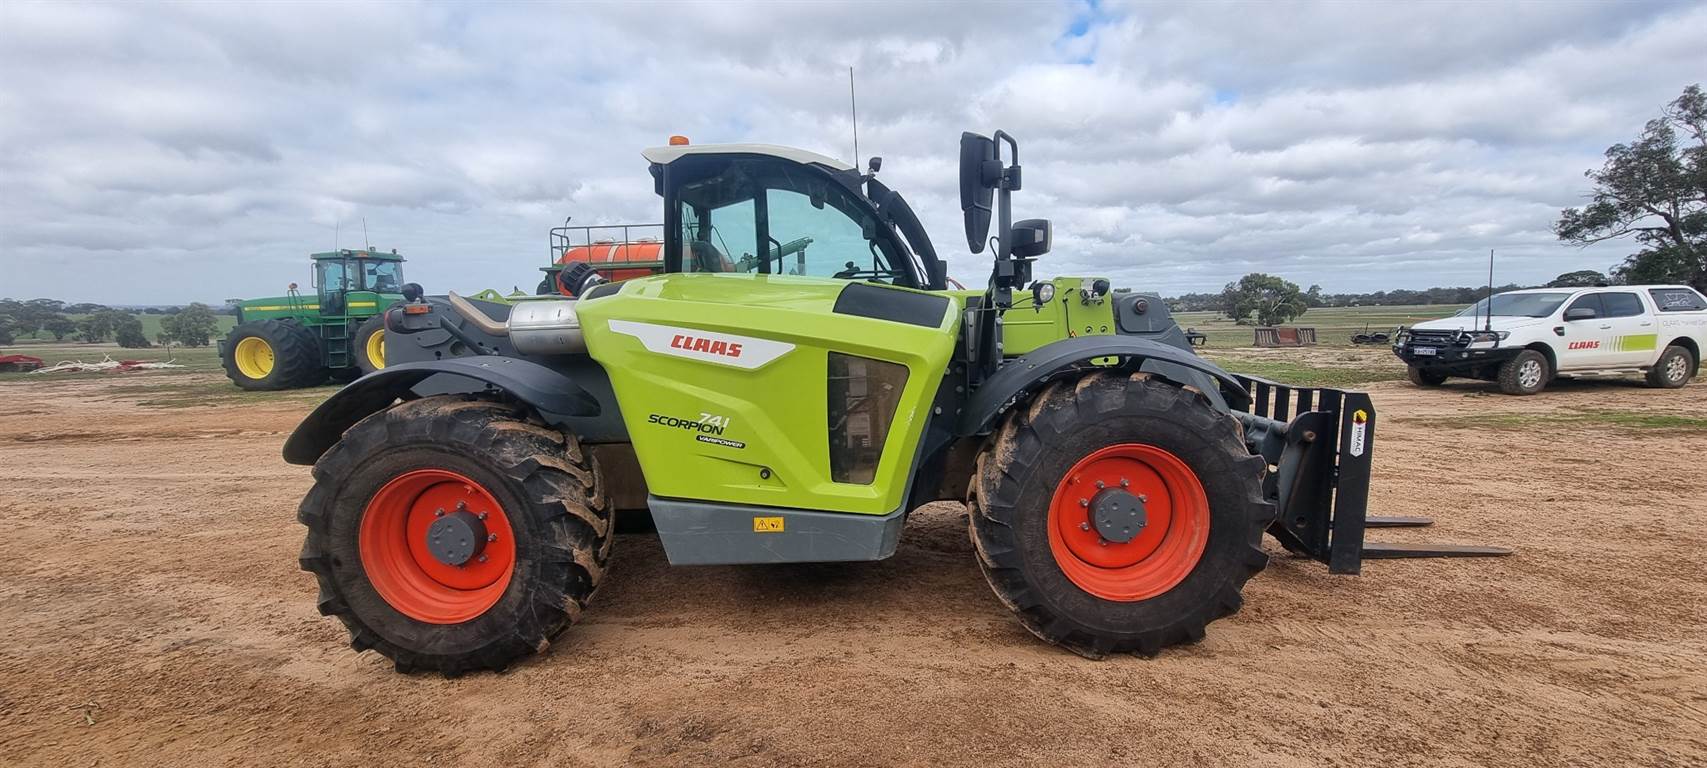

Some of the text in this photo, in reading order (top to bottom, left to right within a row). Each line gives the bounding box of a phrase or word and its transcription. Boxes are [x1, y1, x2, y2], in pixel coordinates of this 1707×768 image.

[671, 335, 743, 357] CLAAS
[1567, 340, 1601, 350] CLAAS
[648, 414, 724, 435] SCORPION
[699, 413, 730, 428] 741
[699, 436, 743, 448] VARIPOWER
[1355, 427, 1363, 452] HIMAC
